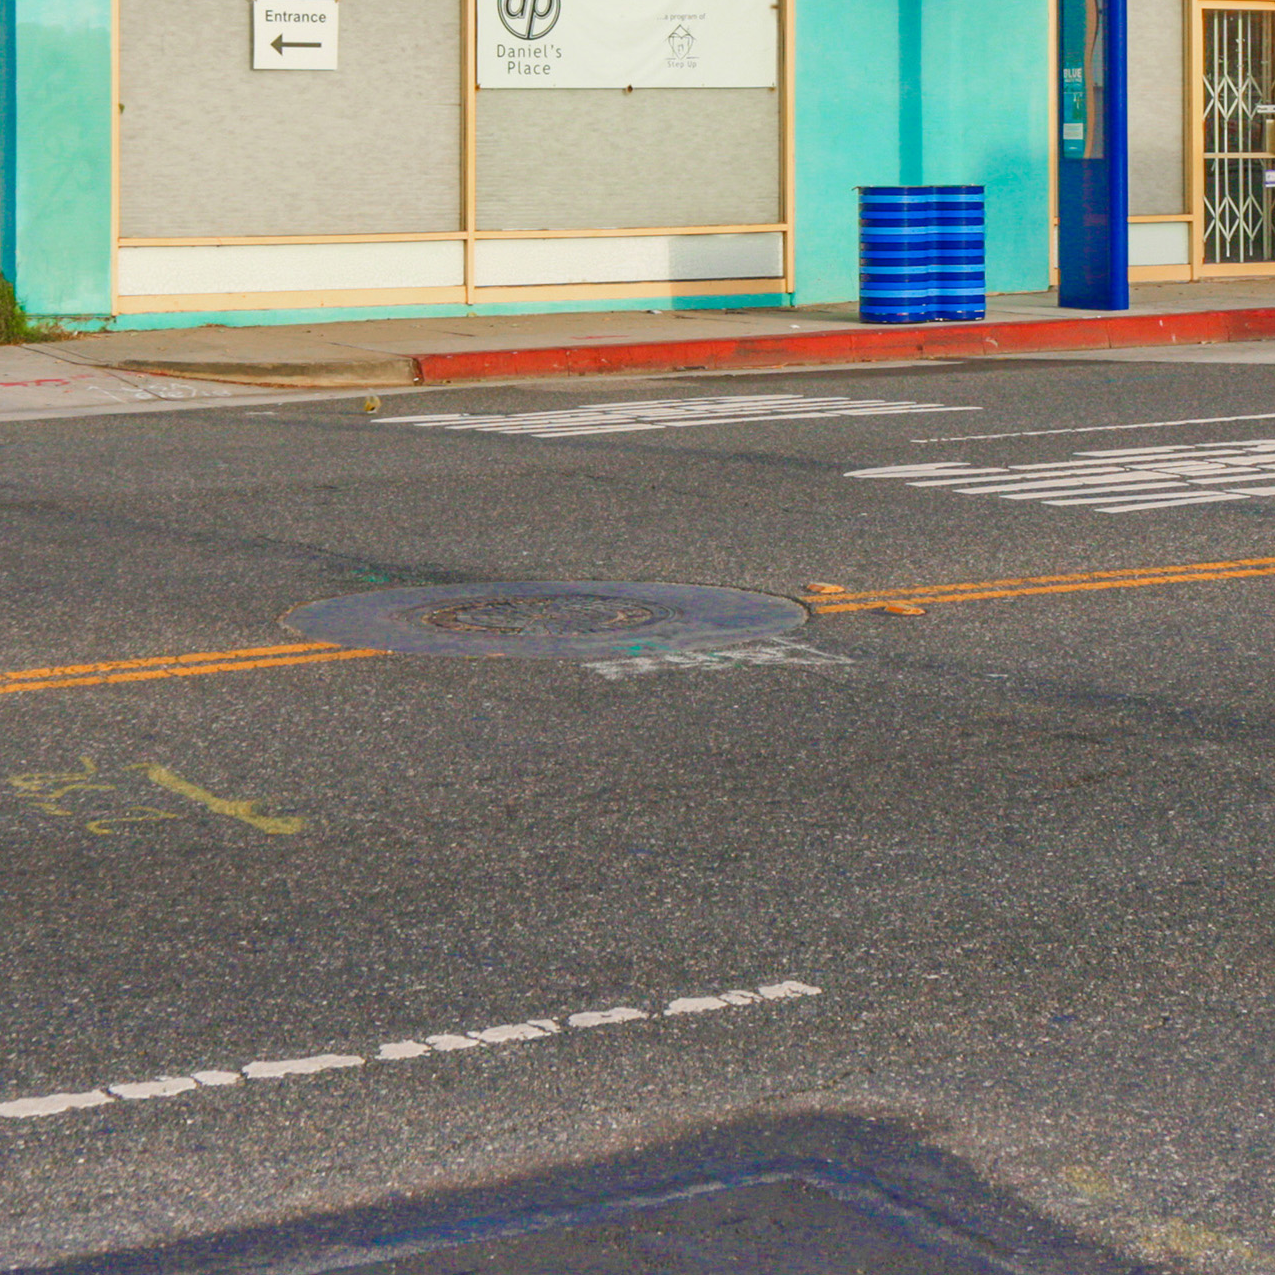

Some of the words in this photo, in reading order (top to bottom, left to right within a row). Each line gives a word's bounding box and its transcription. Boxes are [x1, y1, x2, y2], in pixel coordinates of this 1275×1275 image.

[265, 9, 327, 23] Entrance
[496, 44, 562, 58] Daniel's
[507, 60, 551, 75] Place
